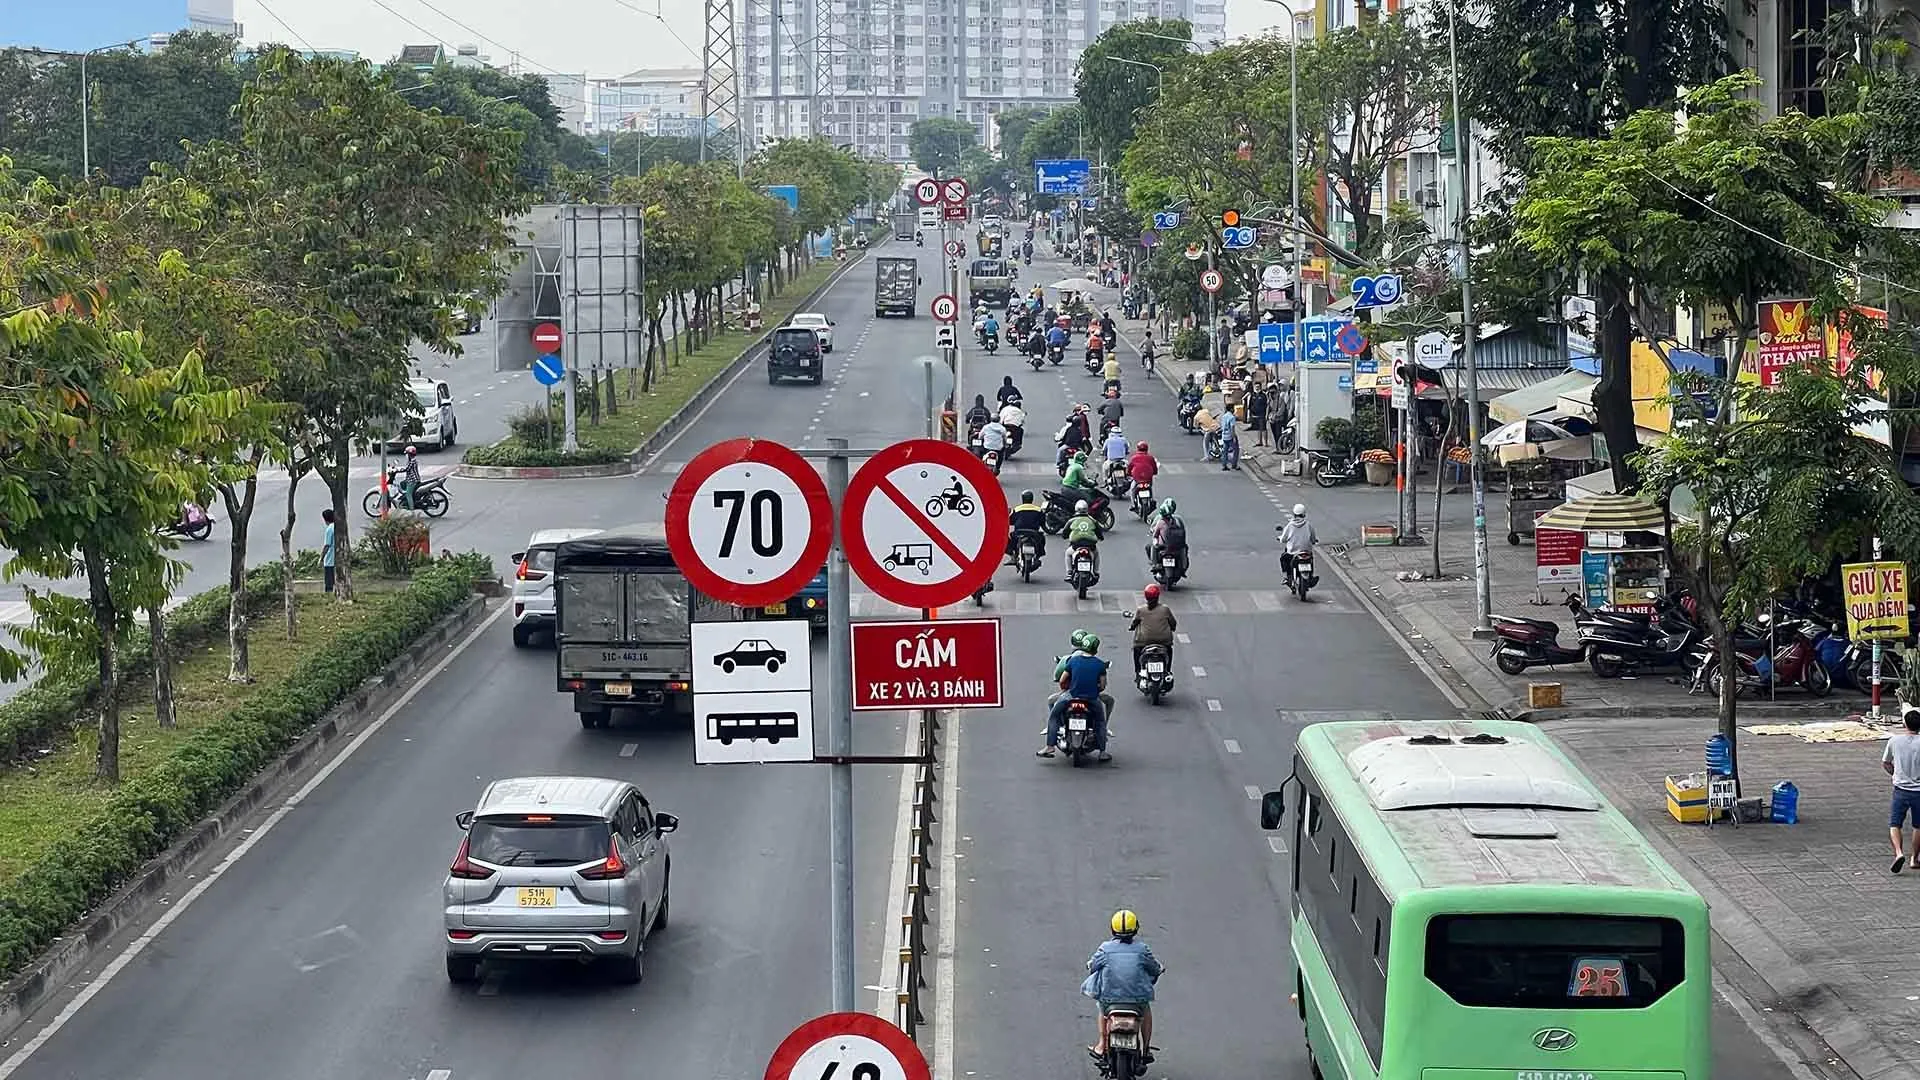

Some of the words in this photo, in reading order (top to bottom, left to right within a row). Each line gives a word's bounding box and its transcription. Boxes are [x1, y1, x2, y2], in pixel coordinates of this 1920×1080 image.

[922, 186, 933, 197] 70
[1206, 275, 1216, 285] 50
[938, 303, 950, 315] 60
[1421, 343, 1443, 355] CIH
[1760, 350, 1820, 367] THANH
[713, 489, 784, 558] 70
[1848, 566, 1876, 596] GIỮ
[1882, 570, 1903, 593] XE
[1852, 603, 1875, 620] QUA
[1878, 597, 1905, 617] ĐÊM
[895, 628, 957, 669] CẤM
[869, 682, 889, 700] XE
[893, 681, 903, 699] 2
[906, 677, 926, 699] VÀ
[930, 680, 940, 698] 3
[944, 676, 985, 698] BÁNH
[528, 888, 545, 897] 51H
[521, 897, 551, 906] 573.24
[1577, 966, 1622, 996] 25
